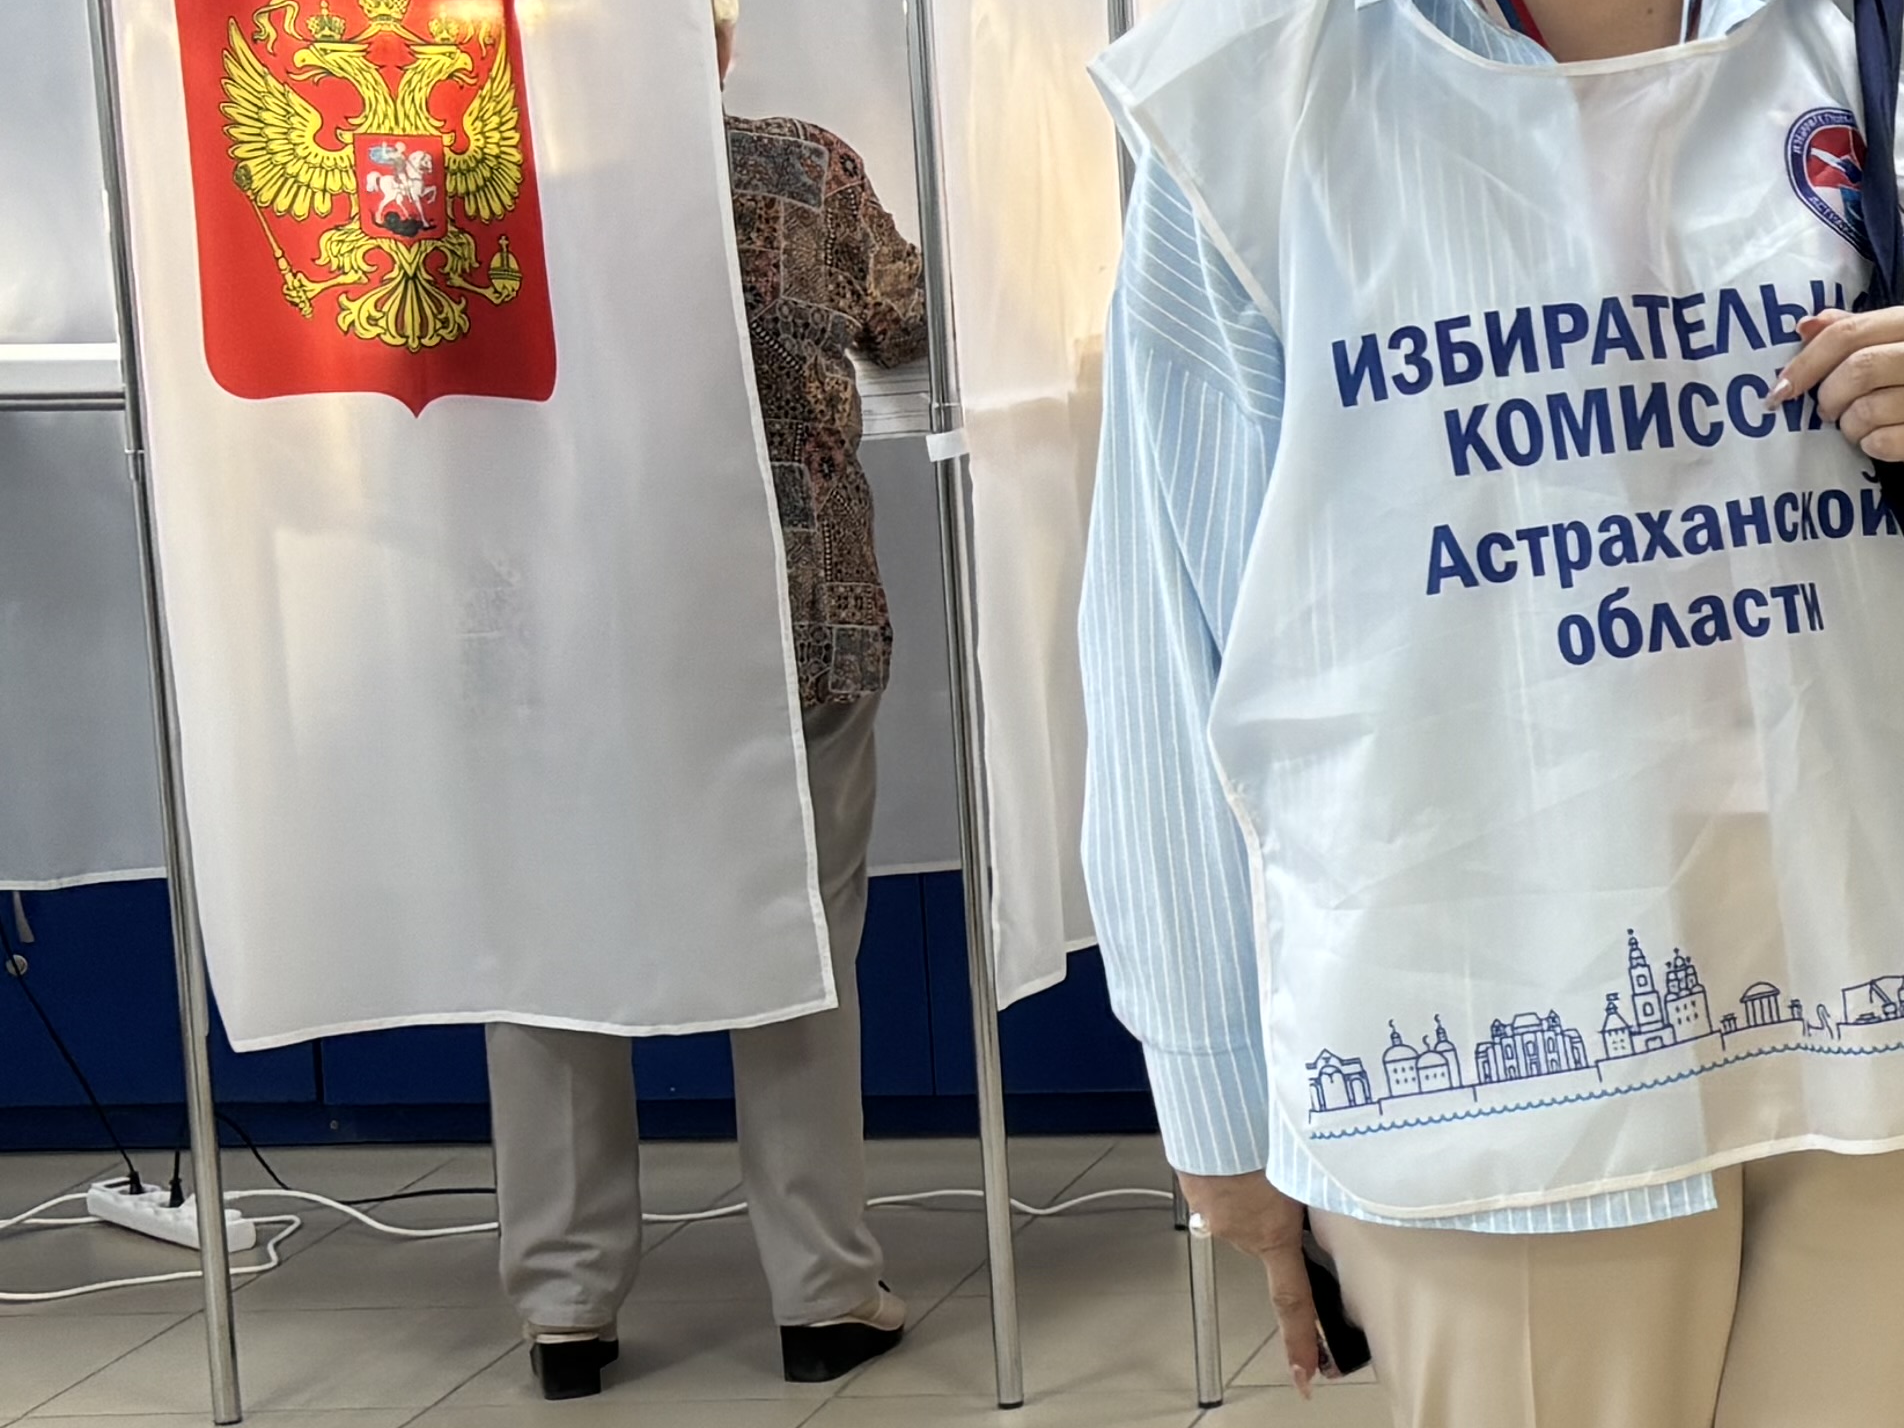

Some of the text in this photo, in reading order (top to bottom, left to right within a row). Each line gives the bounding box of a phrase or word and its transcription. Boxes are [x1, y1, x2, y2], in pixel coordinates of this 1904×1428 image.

[1331, 279, 1868, 407] ИЗБИРАТЕЛЬ
[1443, 368, 1842, 476] КОМИСС
[1425, 470, 1899, 595] Астраханской
[1557, 582, 1825, 666] области
